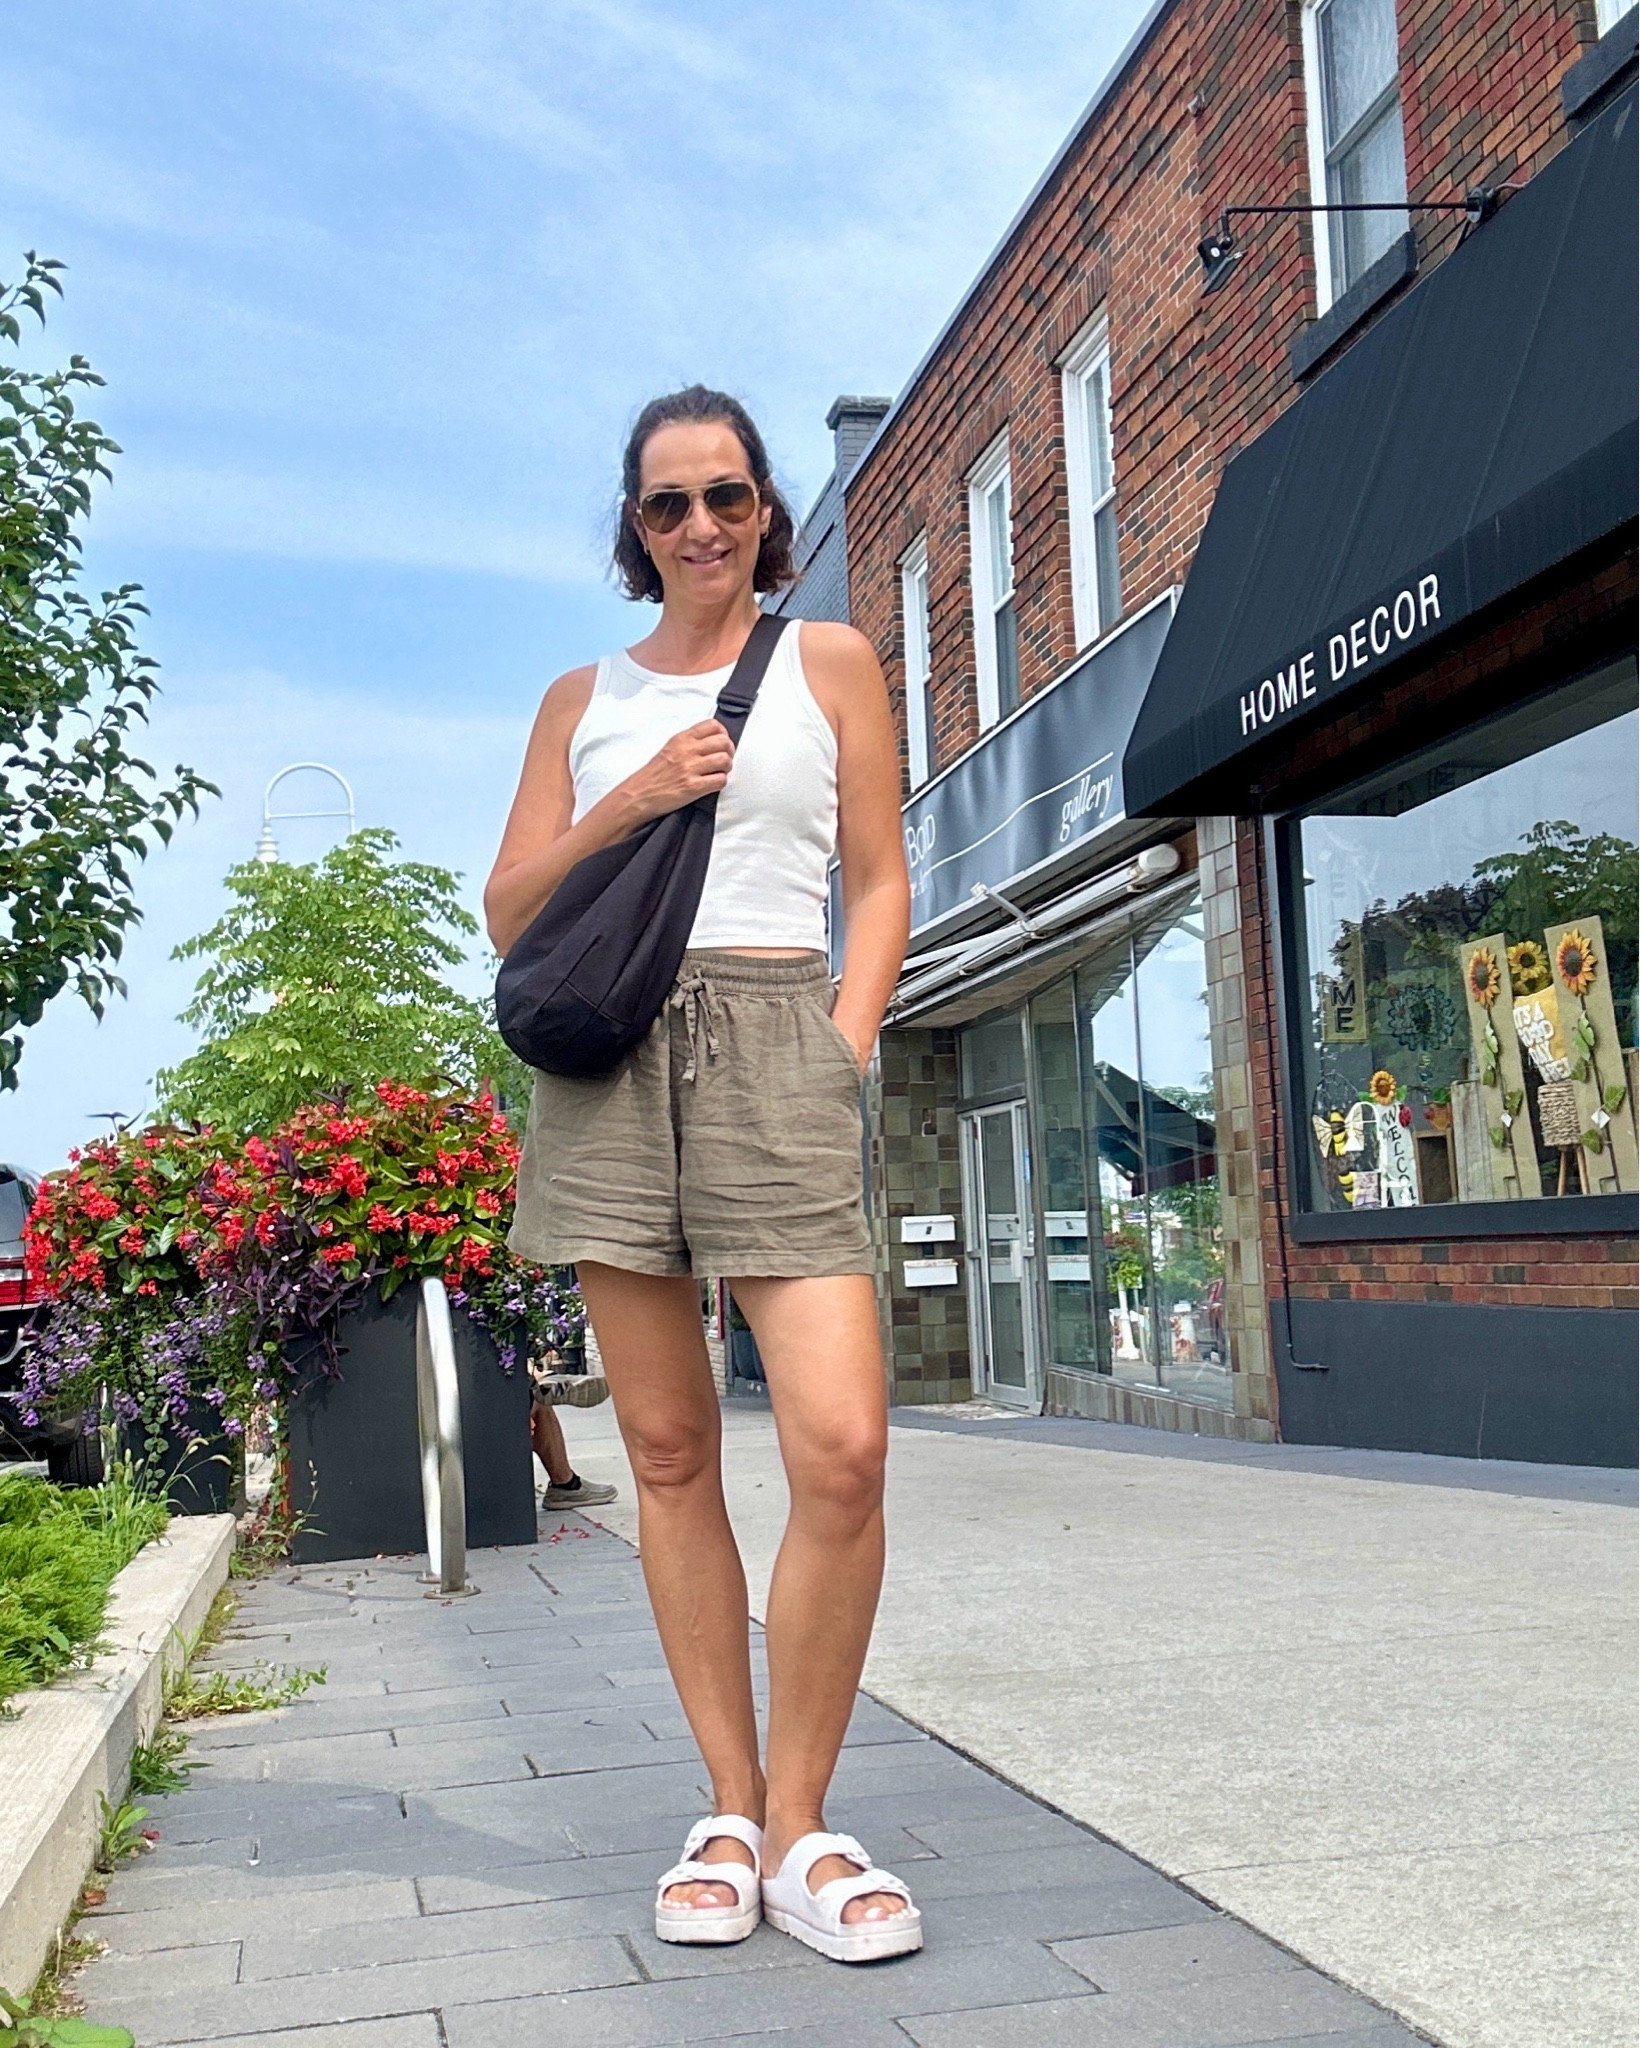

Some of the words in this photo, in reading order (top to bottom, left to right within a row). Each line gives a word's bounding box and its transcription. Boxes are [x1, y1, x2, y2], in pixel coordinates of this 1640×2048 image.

[1239, 651, 1318, 736] HOME
[1328, 573, 1442, 681] DECOR
[1059, 774, 1113, 842] gallery
